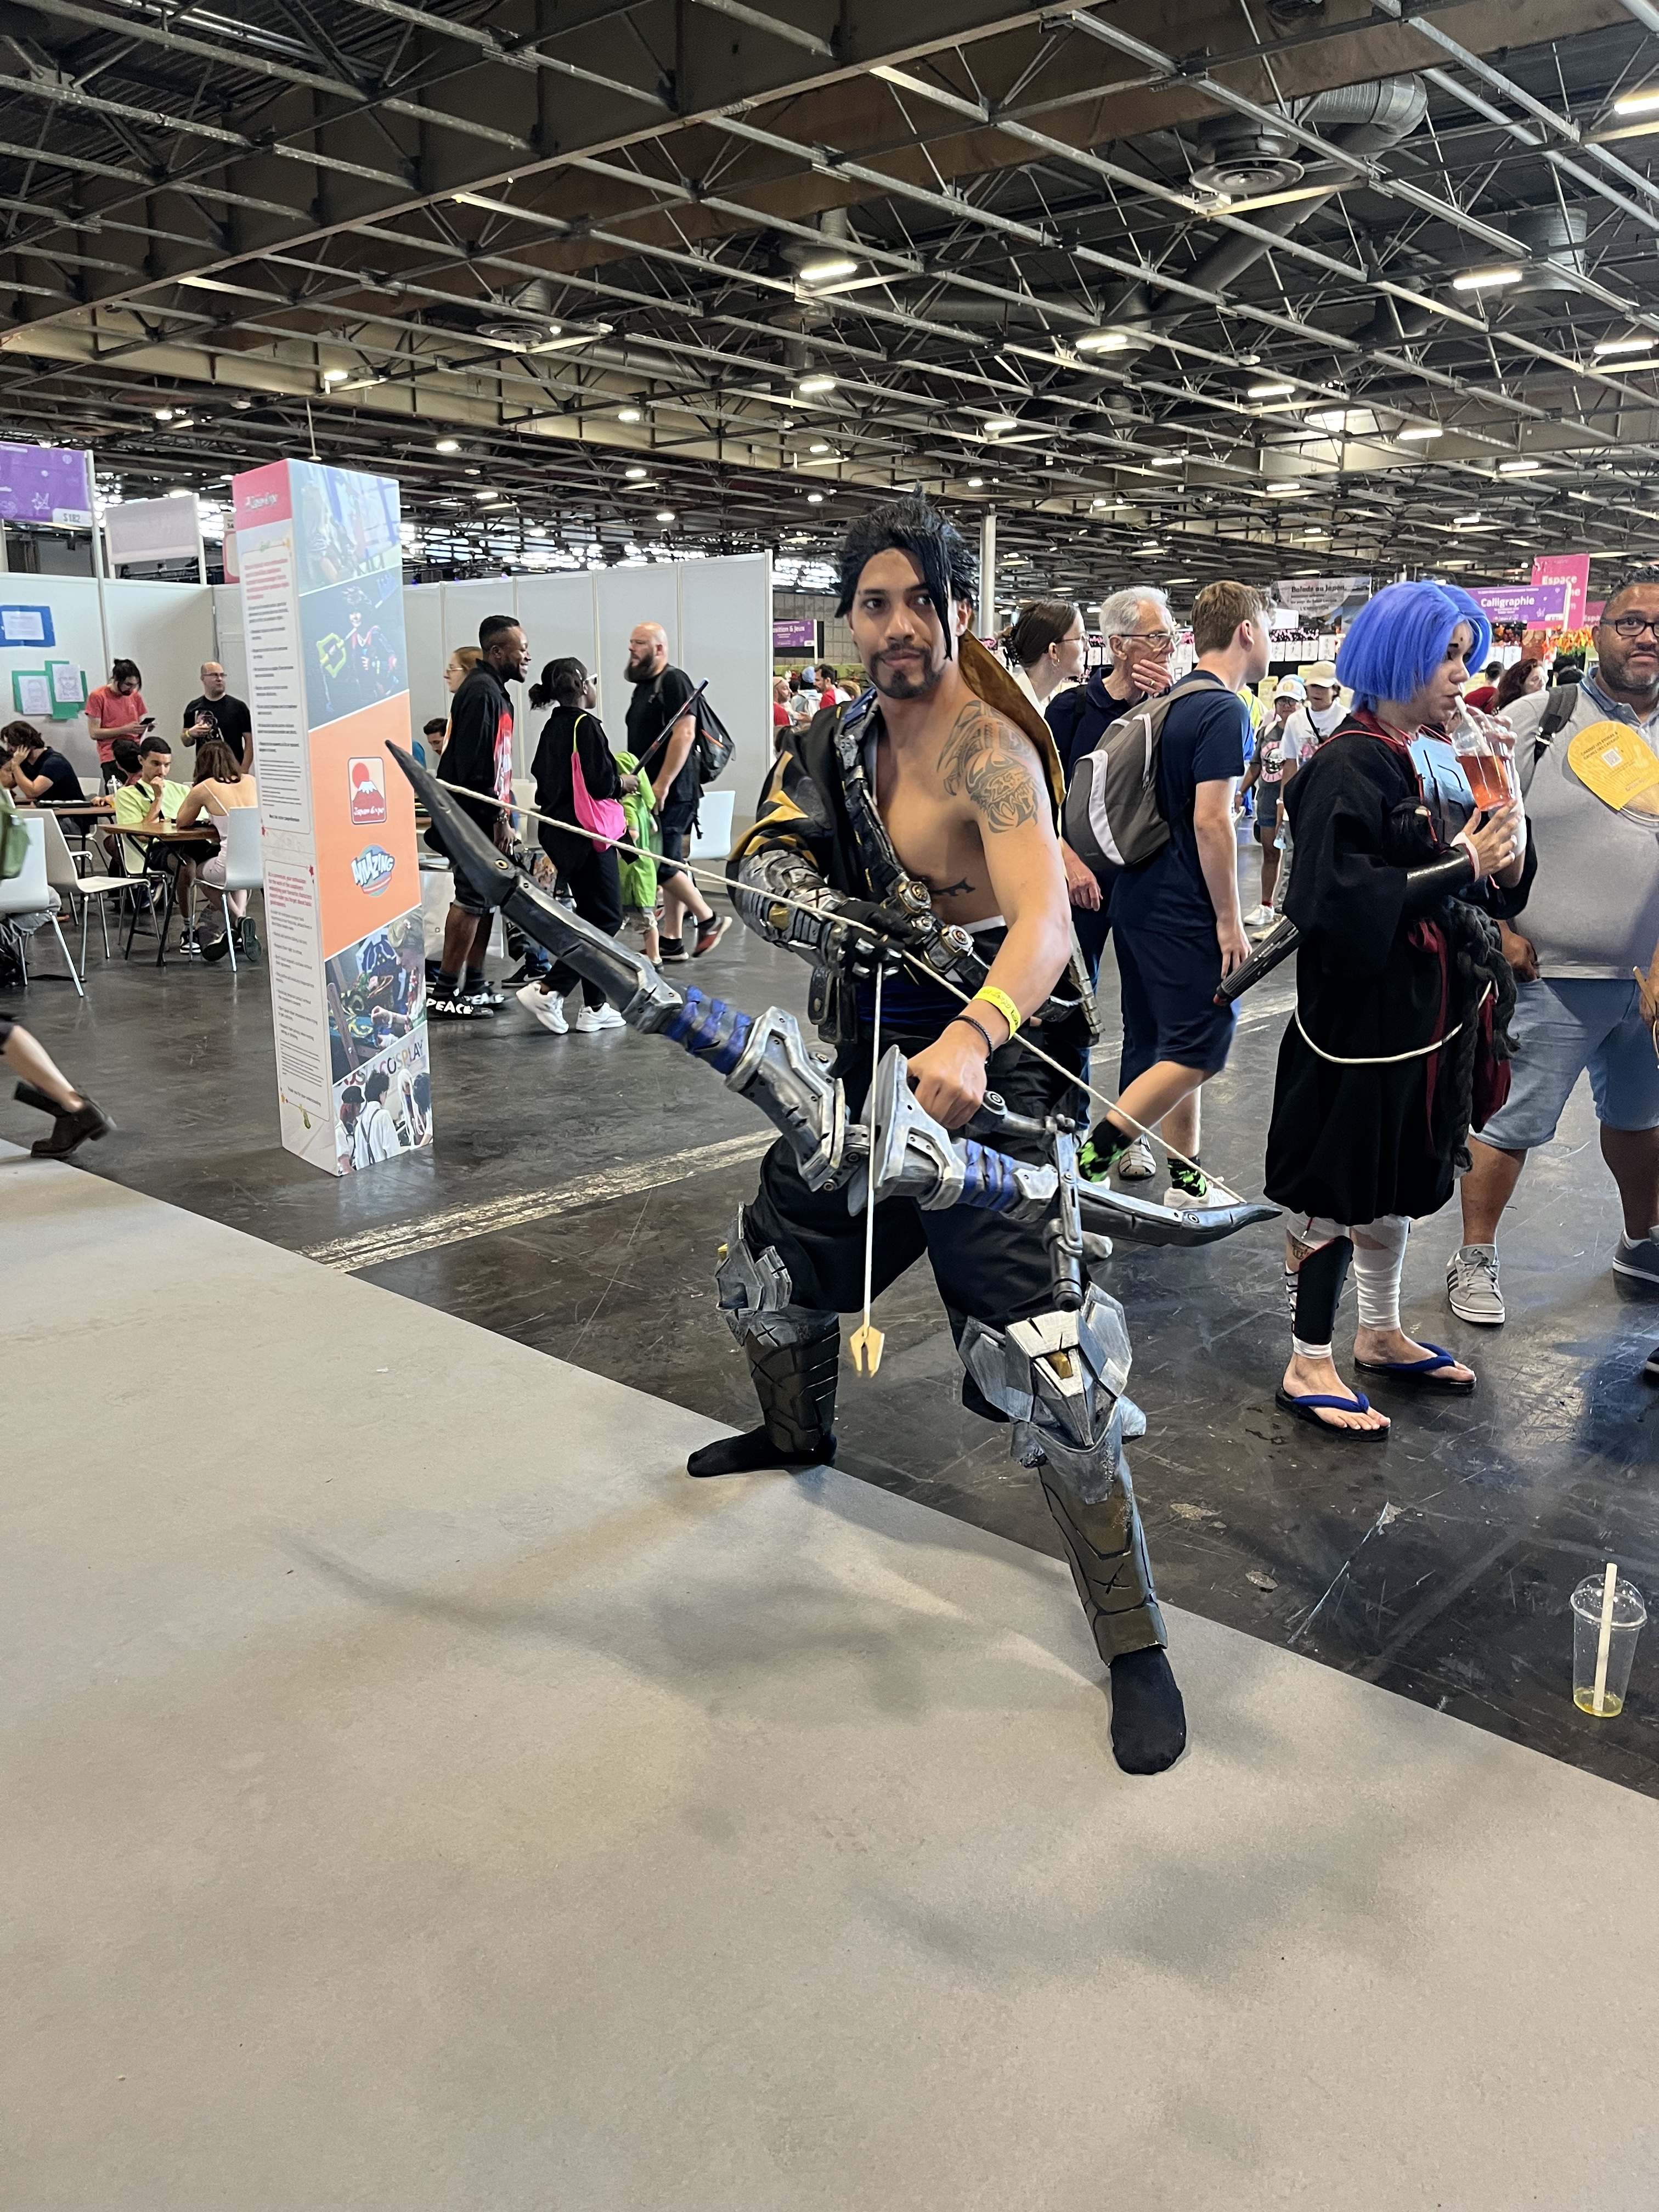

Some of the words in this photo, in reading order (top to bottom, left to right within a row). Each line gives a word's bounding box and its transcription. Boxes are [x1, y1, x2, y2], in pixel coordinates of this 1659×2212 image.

[1542, 575, 1577, 585] Espace
[1481, 596, 1535, 608] Calligraphie
[351, 852, 394, 887] AMAZING
[426, 998, 472, 1014] PEACE
[380, 1039, 423, 1074] COSPLAY
